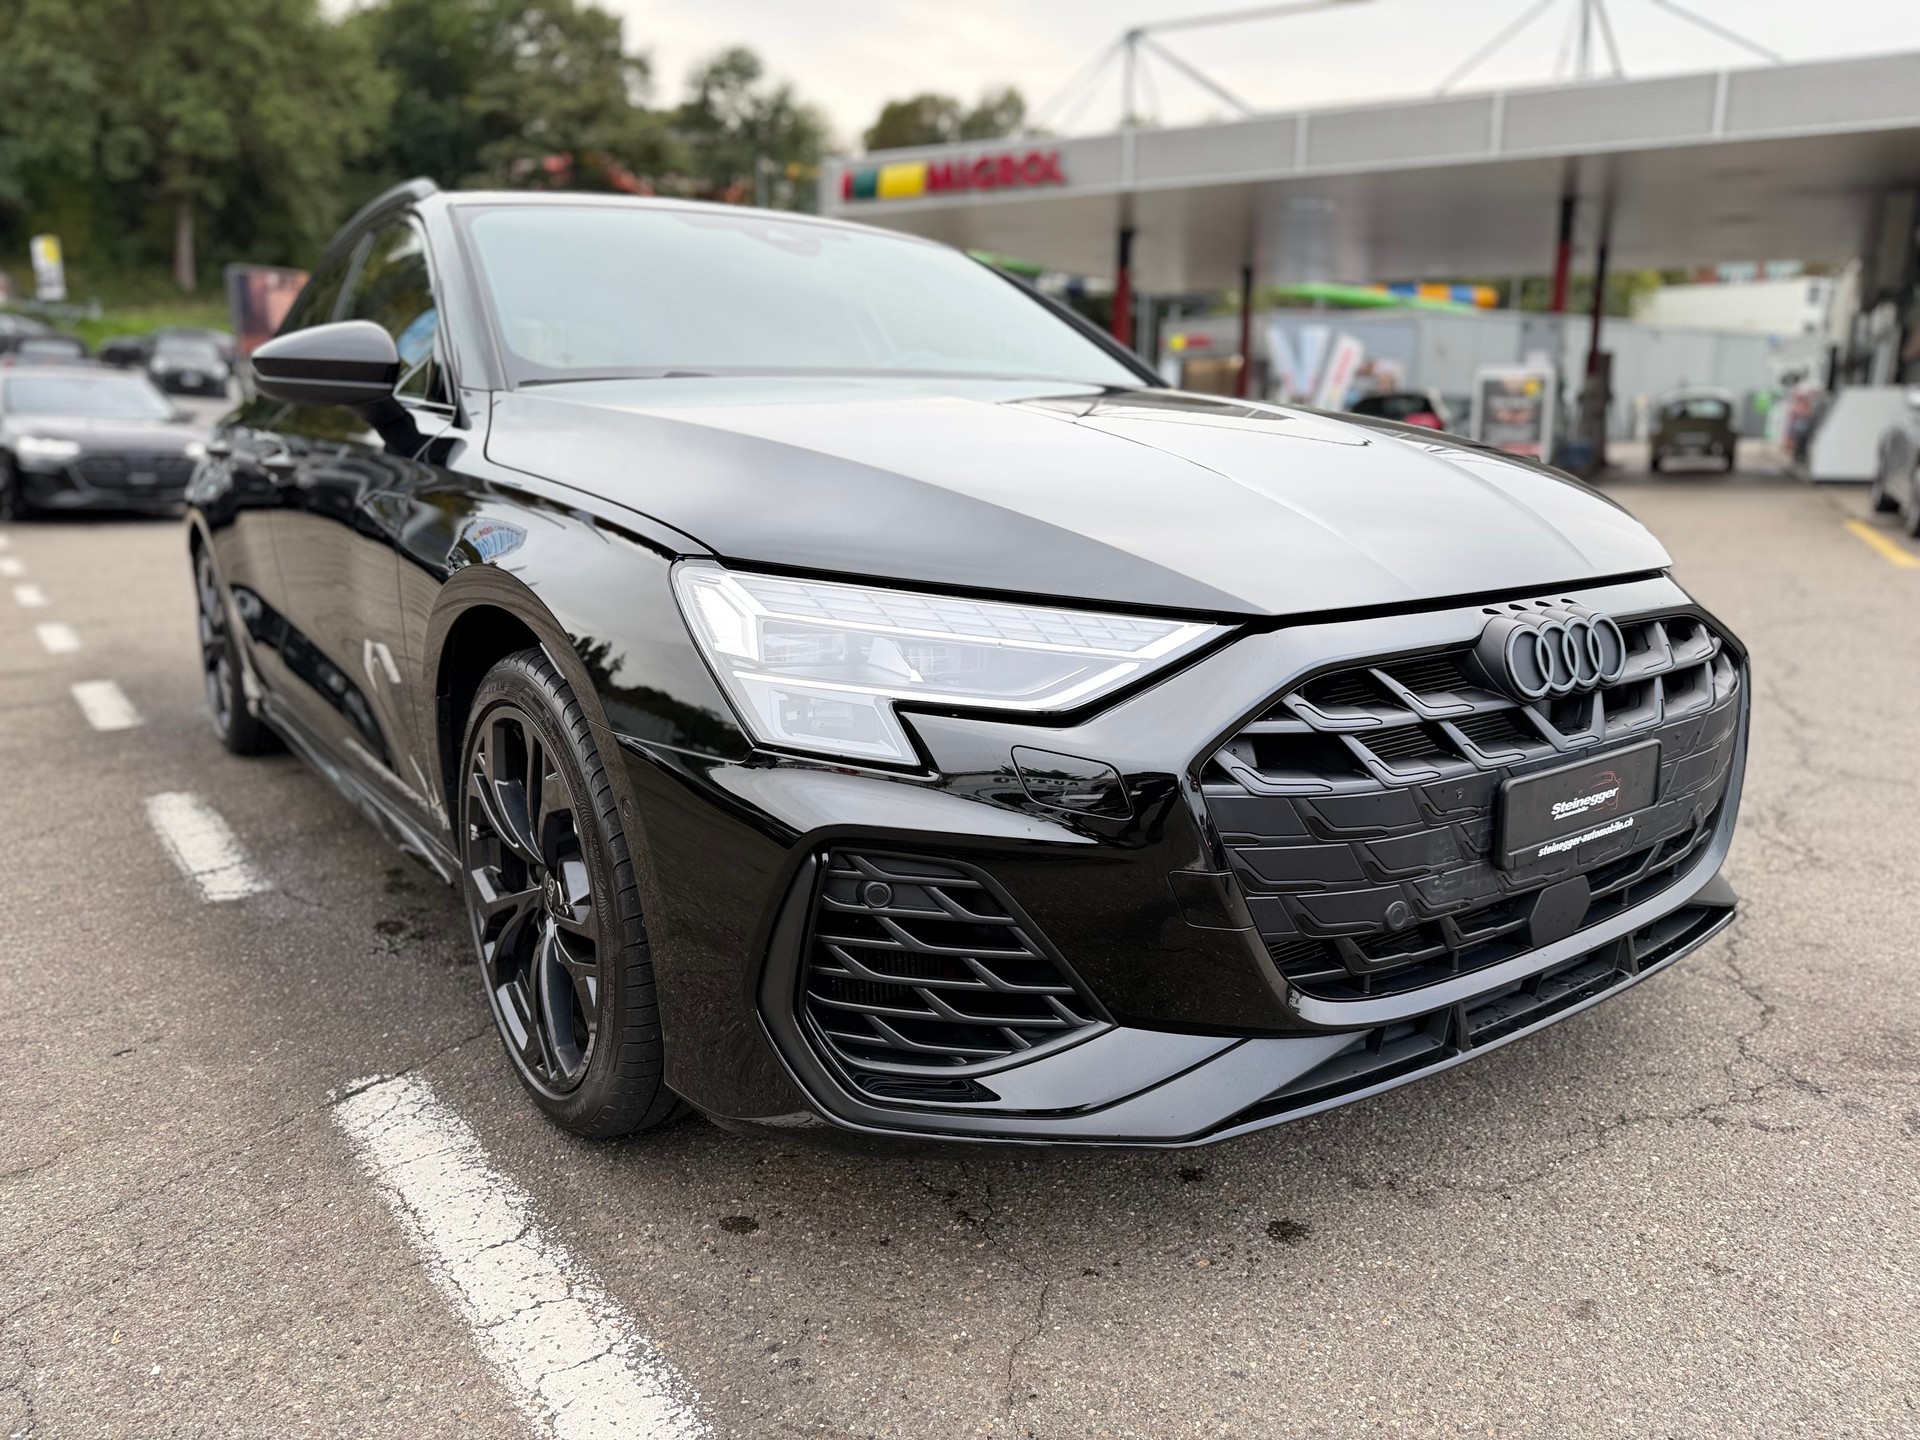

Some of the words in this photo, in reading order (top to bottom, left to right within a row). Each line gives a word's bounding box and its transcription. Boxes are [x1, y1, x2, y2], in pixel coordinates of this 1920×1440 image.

[927, 150, 1066, 192] MIGROL
[1551, 786, 1619, 816] Steinegger
[1538, 817, 1634, 857] steinegger-automobile.ch
